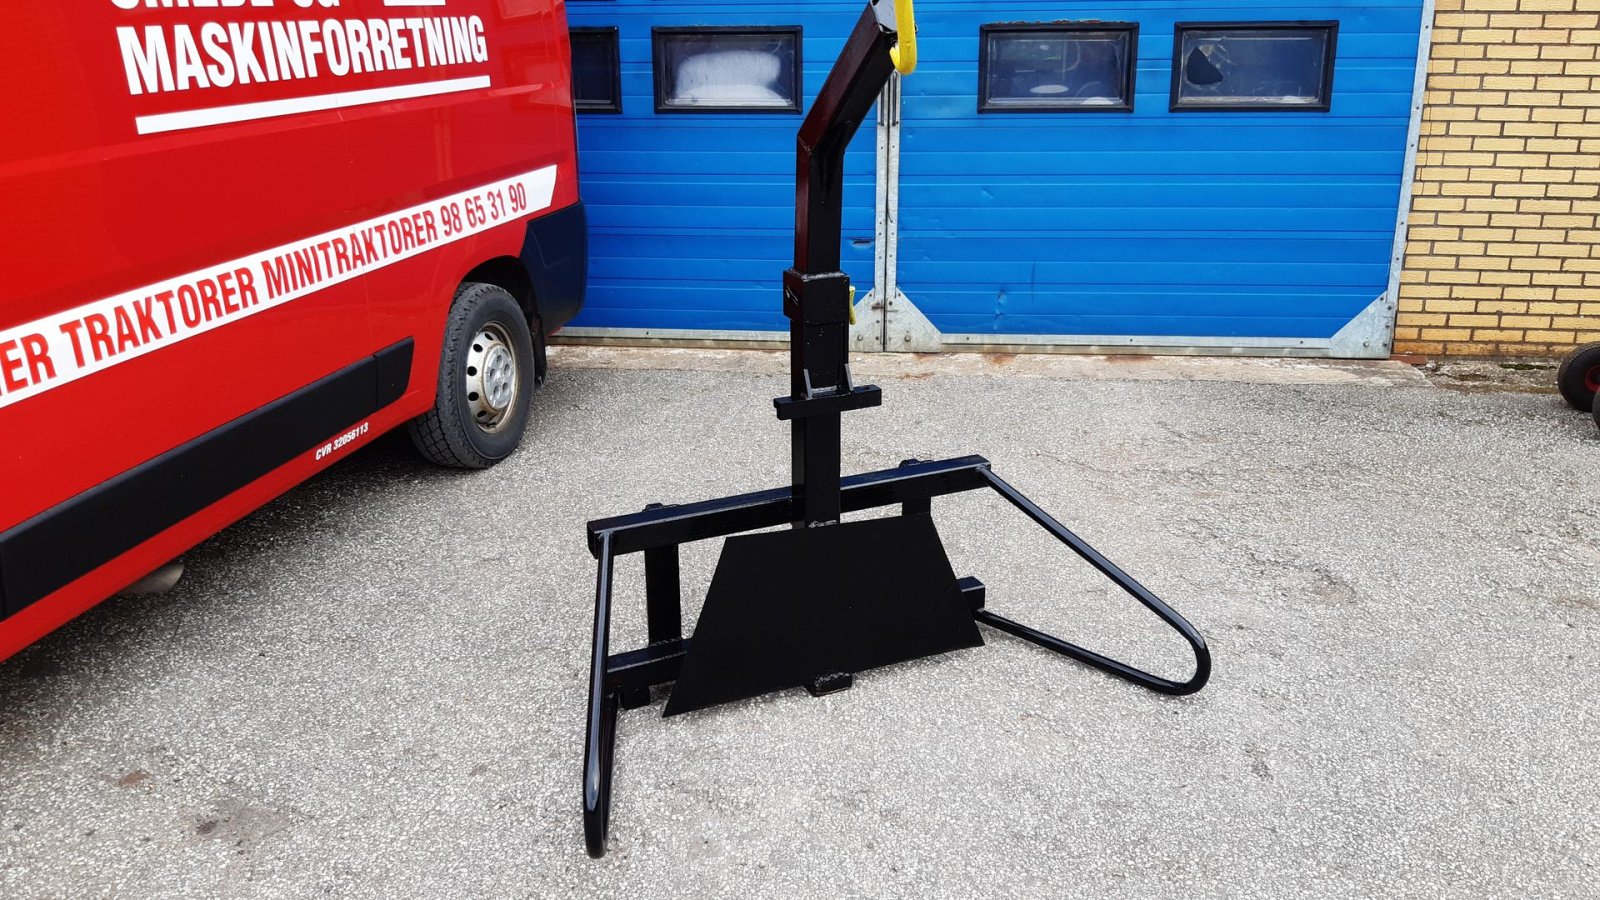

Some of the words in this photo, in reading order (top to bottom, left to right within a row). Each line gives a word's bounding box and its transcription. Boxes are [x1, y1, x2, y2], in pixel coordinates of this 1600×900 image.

[116, 15, 488, 95] MASKINFORRETNING
[0, 333, 57, 396] ER
[59, 267, 259, 368] TRAKTORER
[261, 209, 438, 299] MINITRAKTORER
[440, 202, 463, 236] 98
[464, 195, 486, 228] 65
[487, 189, 506, 220] 31
[508, 182, 527, 213] 90
[315, 443, 332, 460] CVR
[333, 422, 369, 450] 32056113
